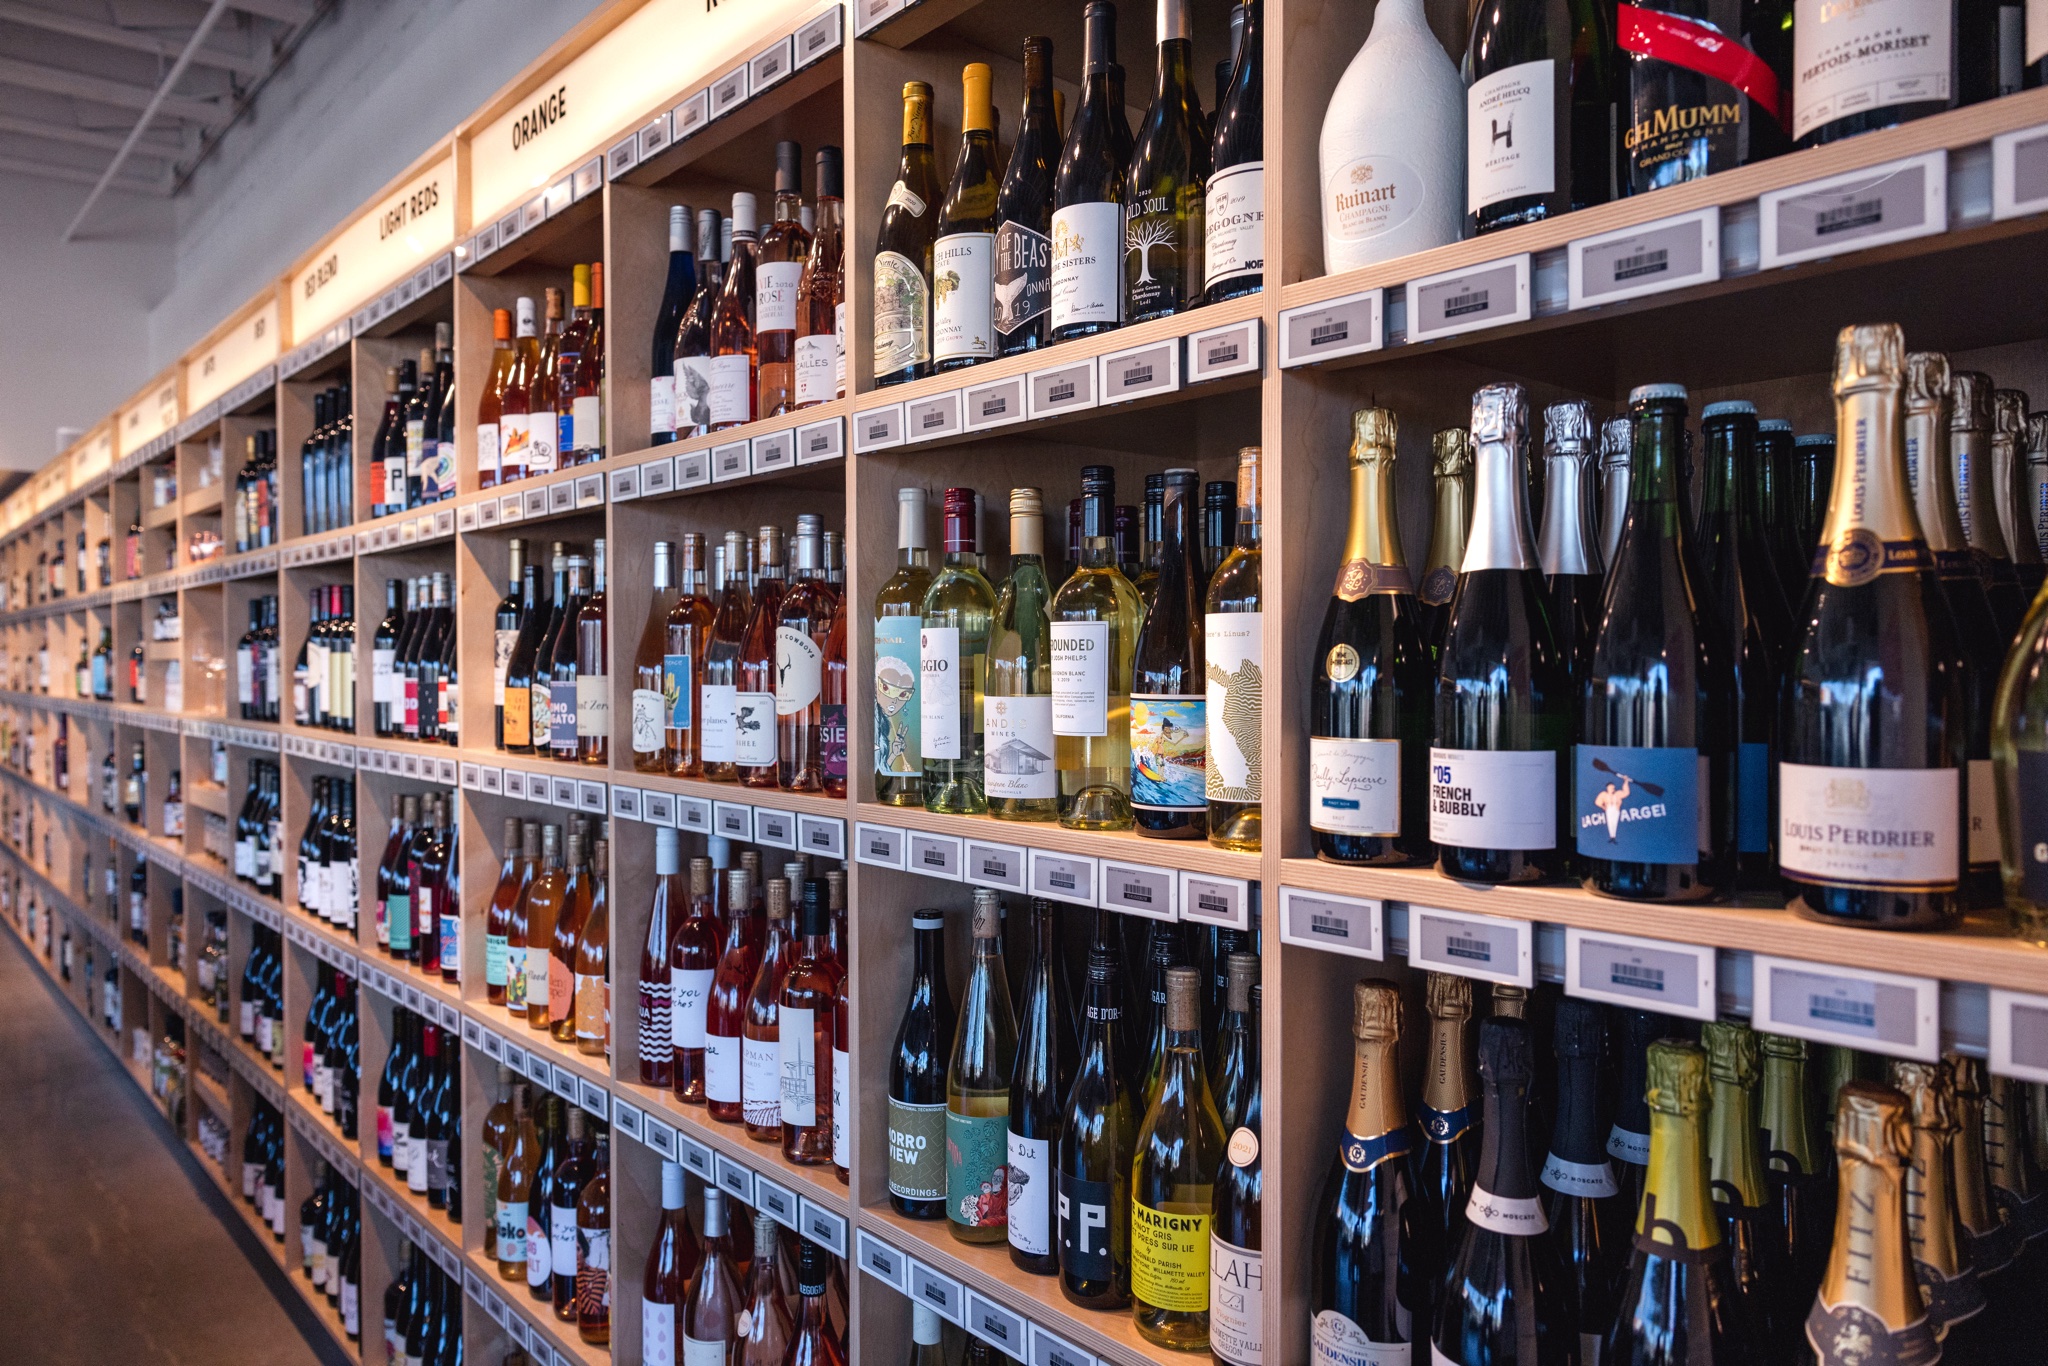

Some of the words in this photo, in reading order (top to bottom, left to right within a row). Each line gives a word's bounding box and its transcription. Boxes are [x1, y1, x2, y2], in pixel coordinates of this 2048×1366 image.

[512, 86, 567, 151] ORANGE
[1143, 197, 1169, 214] SOUL
[1336, 183, 1396, 213] Ruinart
[380, 200, 407, 241] LIGHT
[410, 181, 439, 221] REDS
[1001, 233, 1012, 250] OF
[944, 247, 972, 260] HILLS
[1000, 251, 1011, 272] THE
[1014, 232, 1052, 270] BEAS
[1062, 256, 1096, 269] SISTERS
[1132, 290, 1161, 301] Chardonnay
[1224, 630, 1250, 638] Linus?
[785, 634, 816, 659] COWBOYS
[1007, 778, 1029, 788] Blanc
[1433, 785, 1472, 801] FRENCH
[1439, 800, 1486, 817] BUBBLY
[1785, 818, 1823, 841] LOUIS
[1828, 825, 1935, 848] PERDRIER
[1438, 1032, 1448, 1085] GAUDENSIUS
[1357, 1053, 1369, 1110] GAUDENSIUS
[1232, 1141, 1252, 1154] 2021
[1570, 1176, 1603, 1184] MOSCATO
[1138, 1206, 1203, 1232] MARIGNY
[1138, 1232, 1159, 1248] PRESS
[1162, 1242, 1178, 1252] SUR
[1182, 1245, 1195, 1253] LIE
[1153, 1230, 1172, 1241] GRIS
[1153, 1267, 1185, 1277] WILLAMETTE
[1158, 1260, 1182, 1270] PARISH
